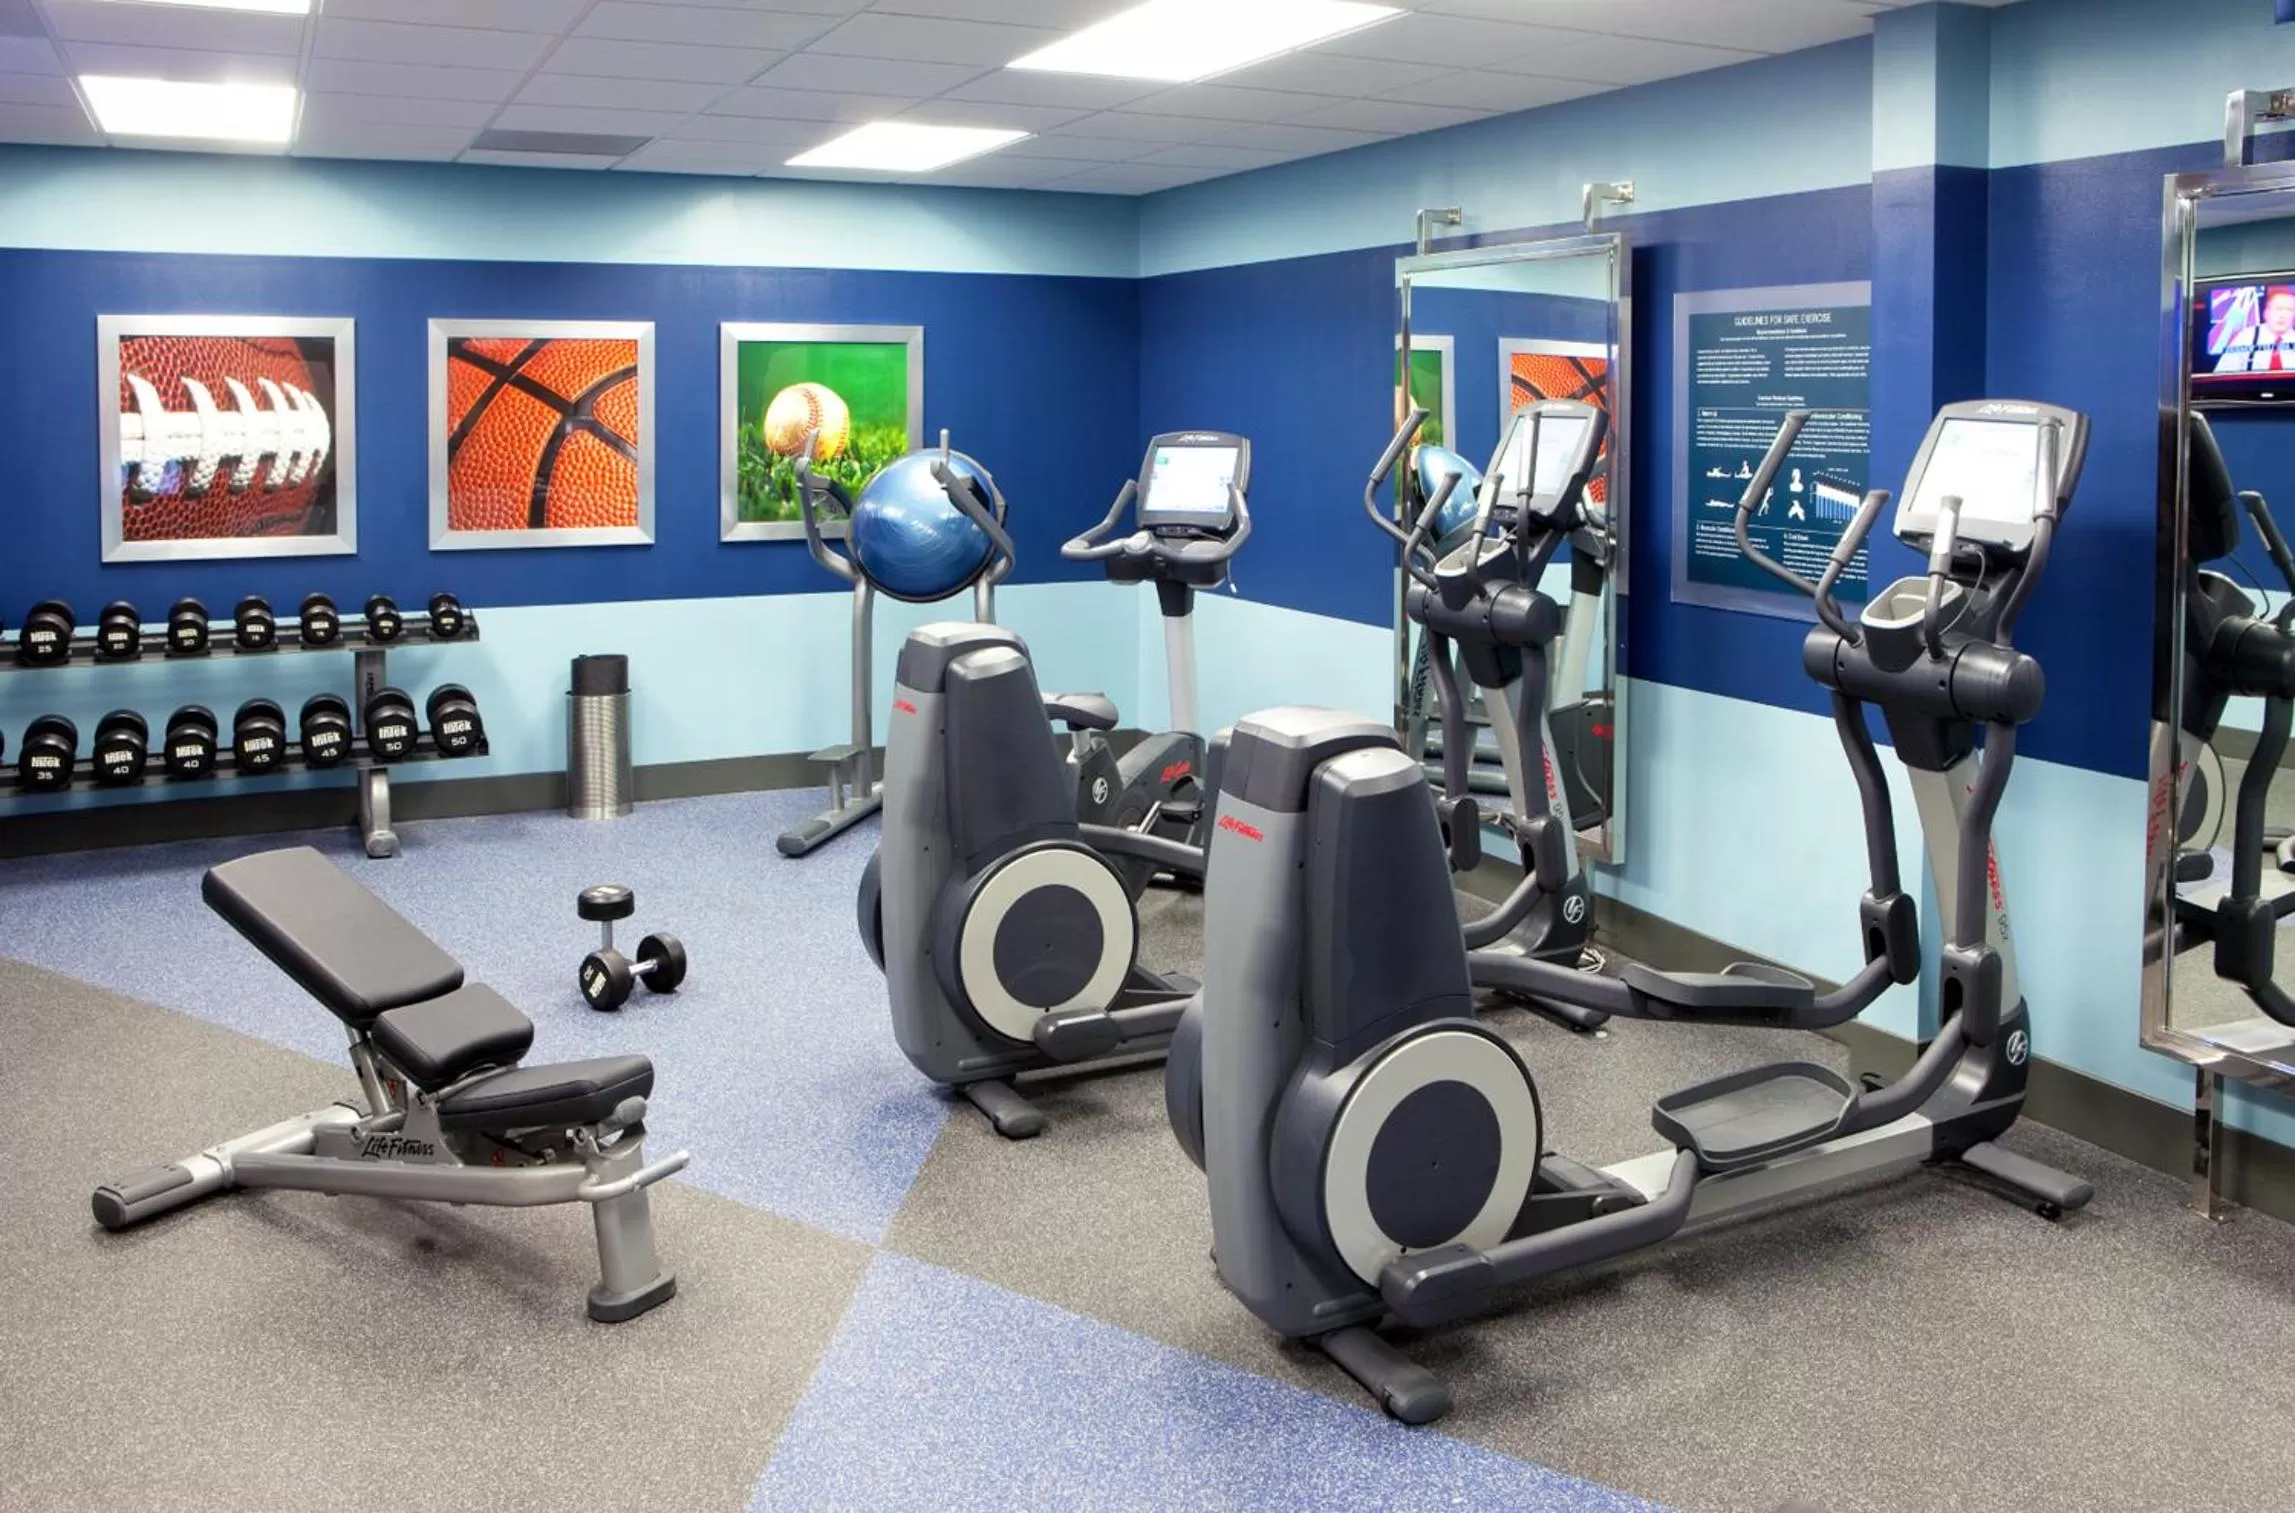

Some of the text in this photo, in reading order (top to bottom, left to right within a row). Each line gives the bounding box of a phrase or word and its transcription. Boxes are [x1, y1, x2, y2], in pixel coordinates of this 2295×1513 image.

[1734, 312, 1832, 326] GUIDELINES FOR SAFE EXERCISE
[451, 736, 467, 746] 50
[386, 741, 402, 752] 50
[321, 748, 338, 757] 45
[253, 754, 270, 763] 45
[183, 759, 200, 769] 40
[37, 771, 54, 780] 35
[113, 766, 130, 775] 40
[361, 1136, 435, 1159] Life Fitness
